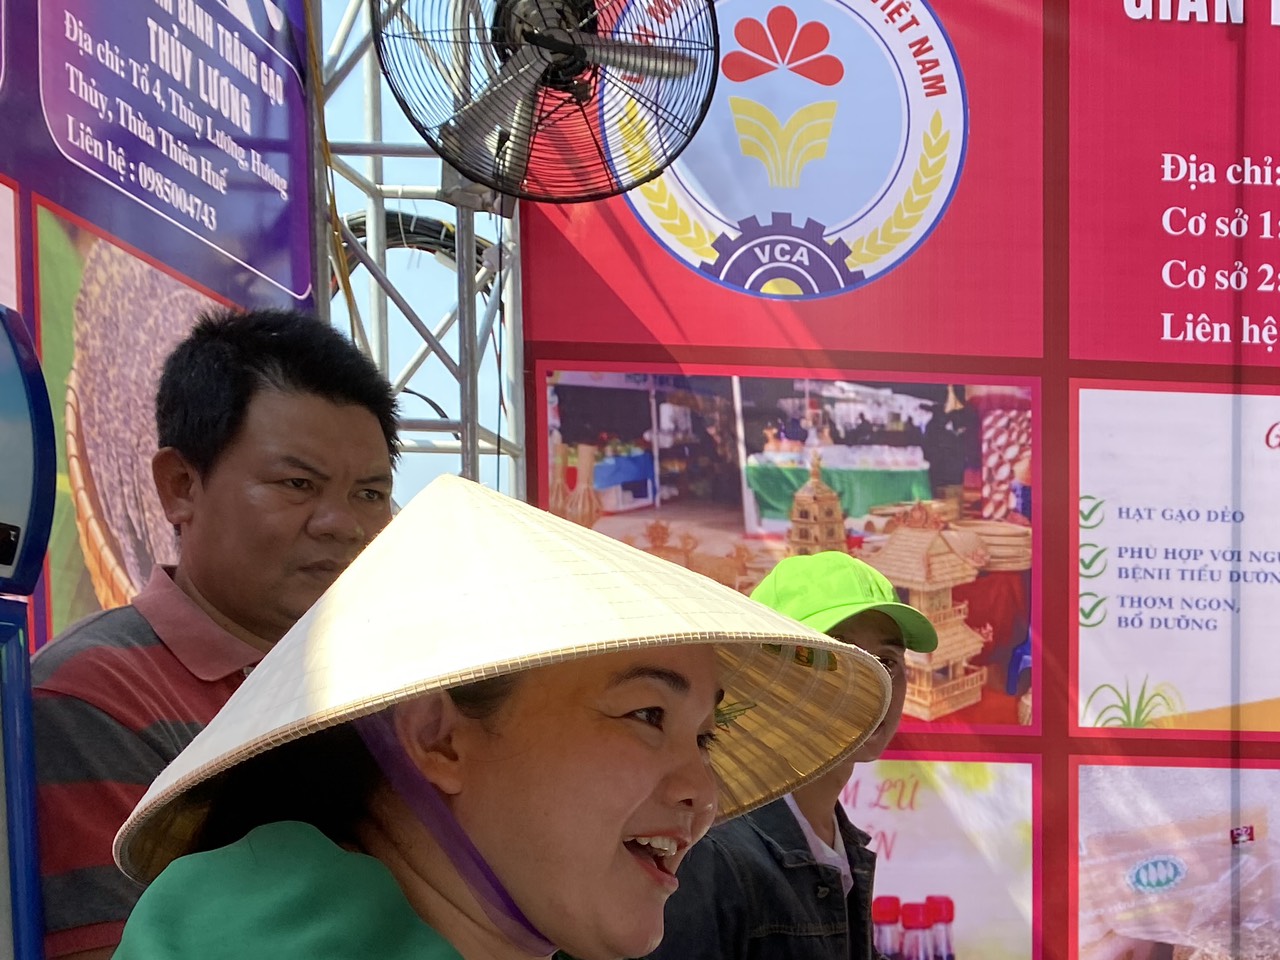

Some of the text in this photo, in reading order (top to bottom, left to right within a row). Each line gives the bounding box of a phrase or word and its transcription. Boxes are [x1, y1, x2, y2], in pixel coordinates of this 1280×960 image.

[871, 0, 947, 98] IỆT NAM
[64, 9, 93, 56] Địa
[97, 39, 126, 79] chỉ:
[129, 58, 149, 95] Tổ
[152, 78, 166, 112] 4,
[168, 88, 203, 139] Thủy
[147, 17, 252, 136] THỦY LƯƠNG
[260, 61, 285, 106] GẠO
[65, 61, 229, 196] Thủy, Thừa Thiên Huế
[66, 114, 105, 164] Liên
[138, 161, 218, 232] 0985004743
[1161, 153, 1217, 191] Địa
[1161, 206, 1208, 237] Cơ
[1215, 208, 1249, 238] sở
[754, 243, 811, 267] VCA
[1161, 259, 1207, 290] Cơ
[1215, 260, 1248, 291] sở
[1160, 312, 1233, 344] Liên
[1117, 506, 1245, 525] HẠT GẠO DẺO
[1117, 544, 1158, 561] PHÙ
[1163, 547, 1204, 564] HỢP
[1117, 565, 1171, 584] BỆNH
[1177, 564, 1222, 583] TIỂU
